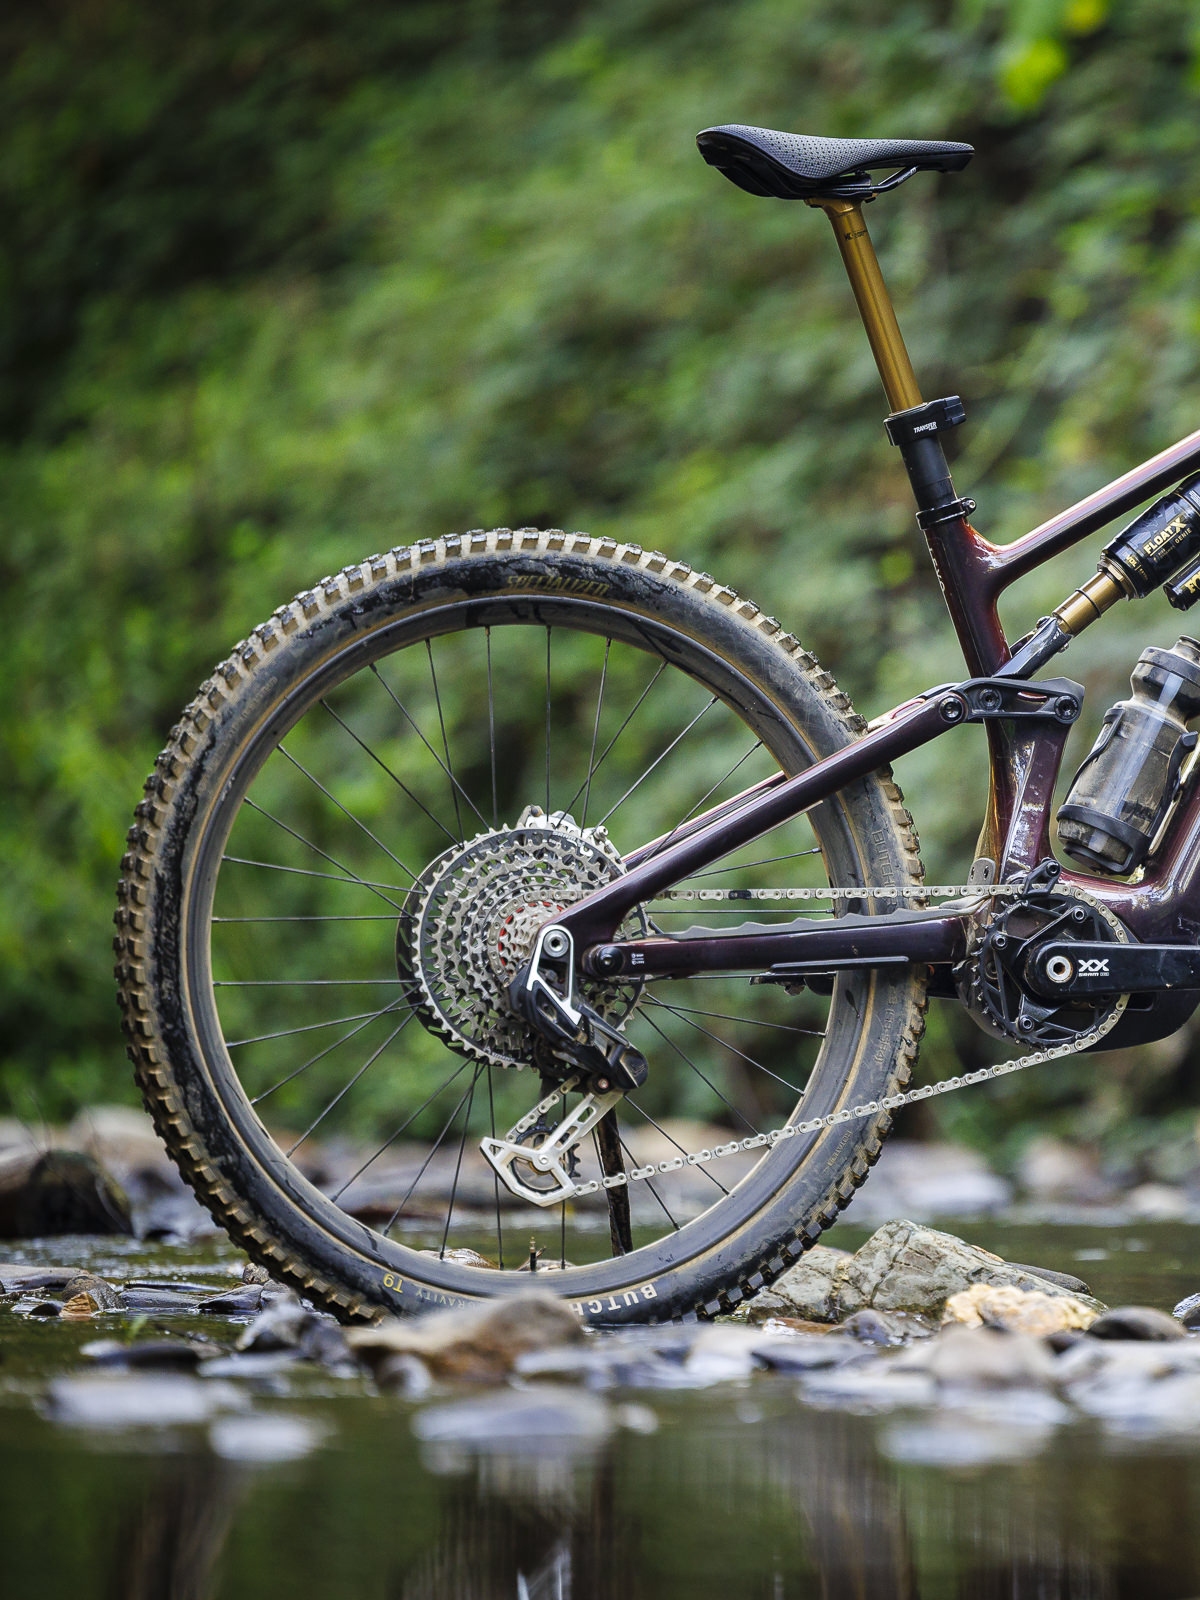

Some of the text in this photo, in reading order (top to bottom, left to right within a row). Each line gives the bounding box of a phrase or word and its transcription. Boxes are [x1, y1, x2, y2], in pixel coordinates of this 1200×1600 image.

[913, 421, 937, 433] TRANSFER
[1175, 527, 1193, 544] GENIE
[1078, 959, 1110, 972] XX
[383, 1273, 404, 1294] T9
[568, 1284, 658, 1316] BUTCH
